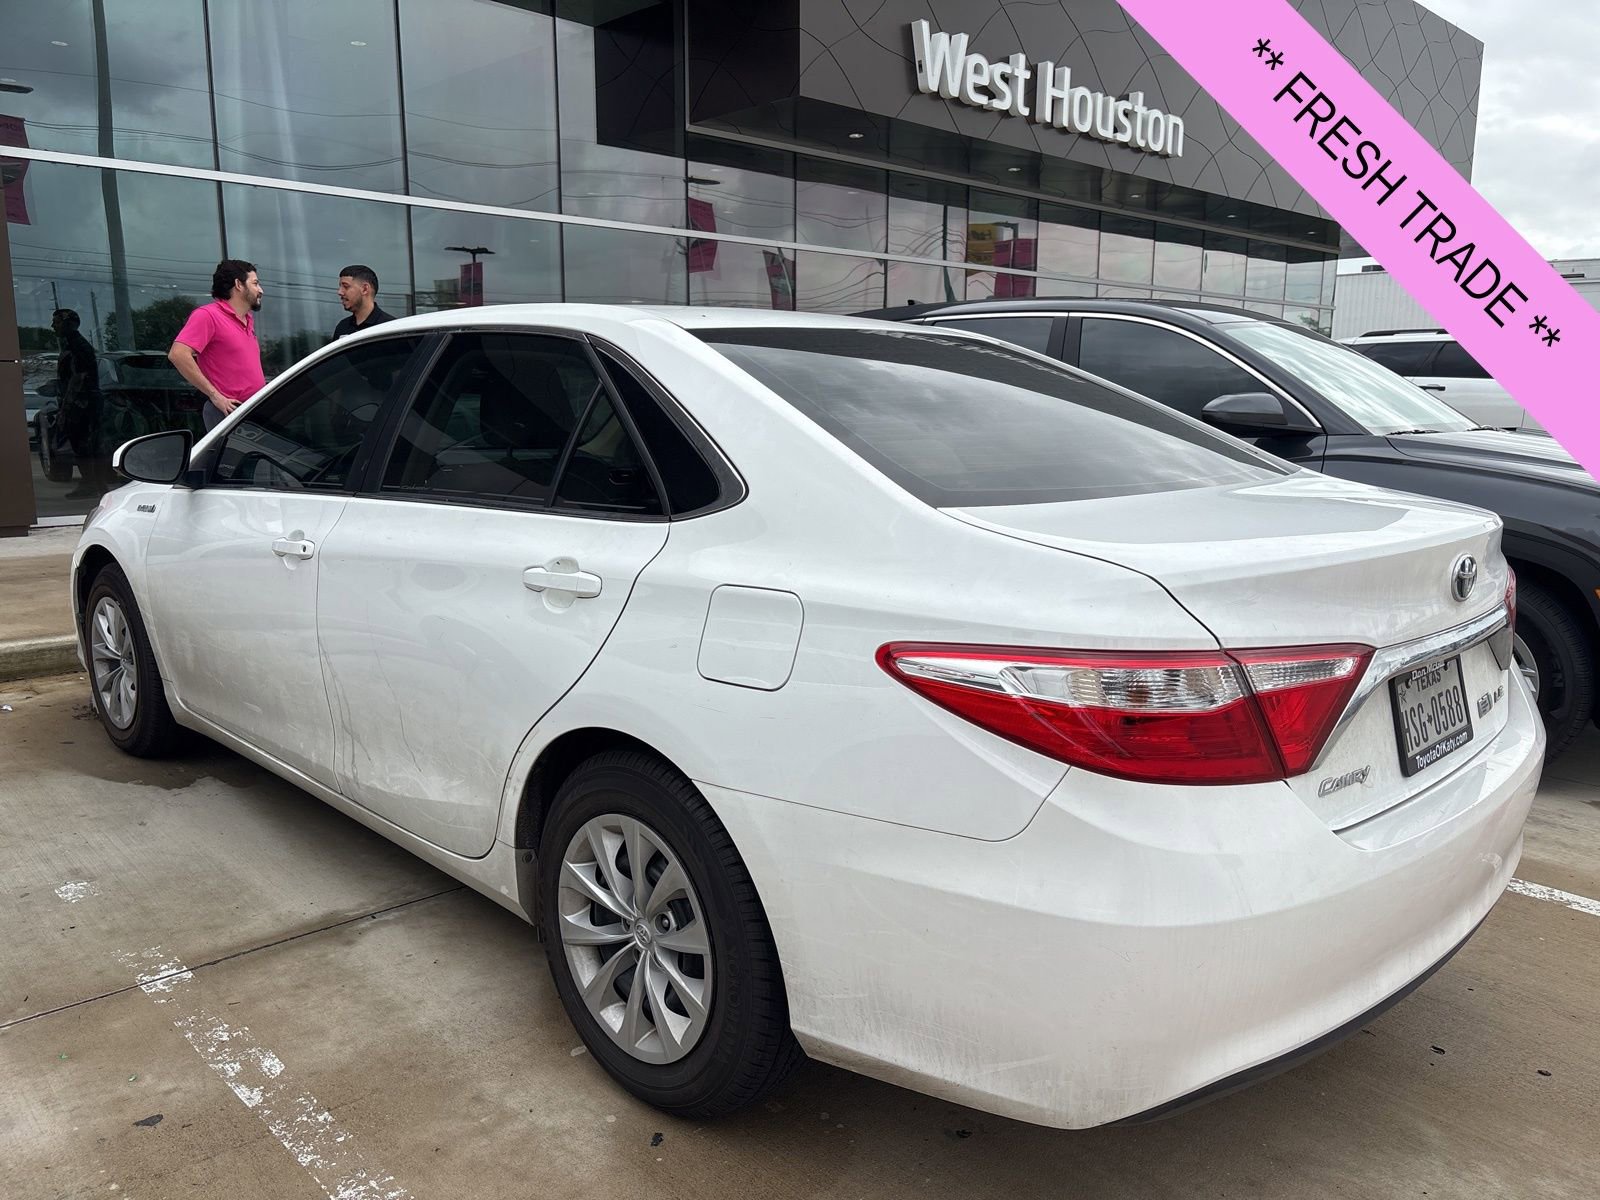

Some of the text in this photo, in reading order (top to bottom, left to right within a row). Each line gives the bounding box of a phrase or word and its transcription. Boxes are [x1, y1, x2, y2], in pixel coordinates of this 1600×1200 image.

[911, 18, 1184, 158] West Houston
[1417, 670, 1441, 692] TEXAS
[1415, 731, 1469, 770] ToyotaOfKaty.com
